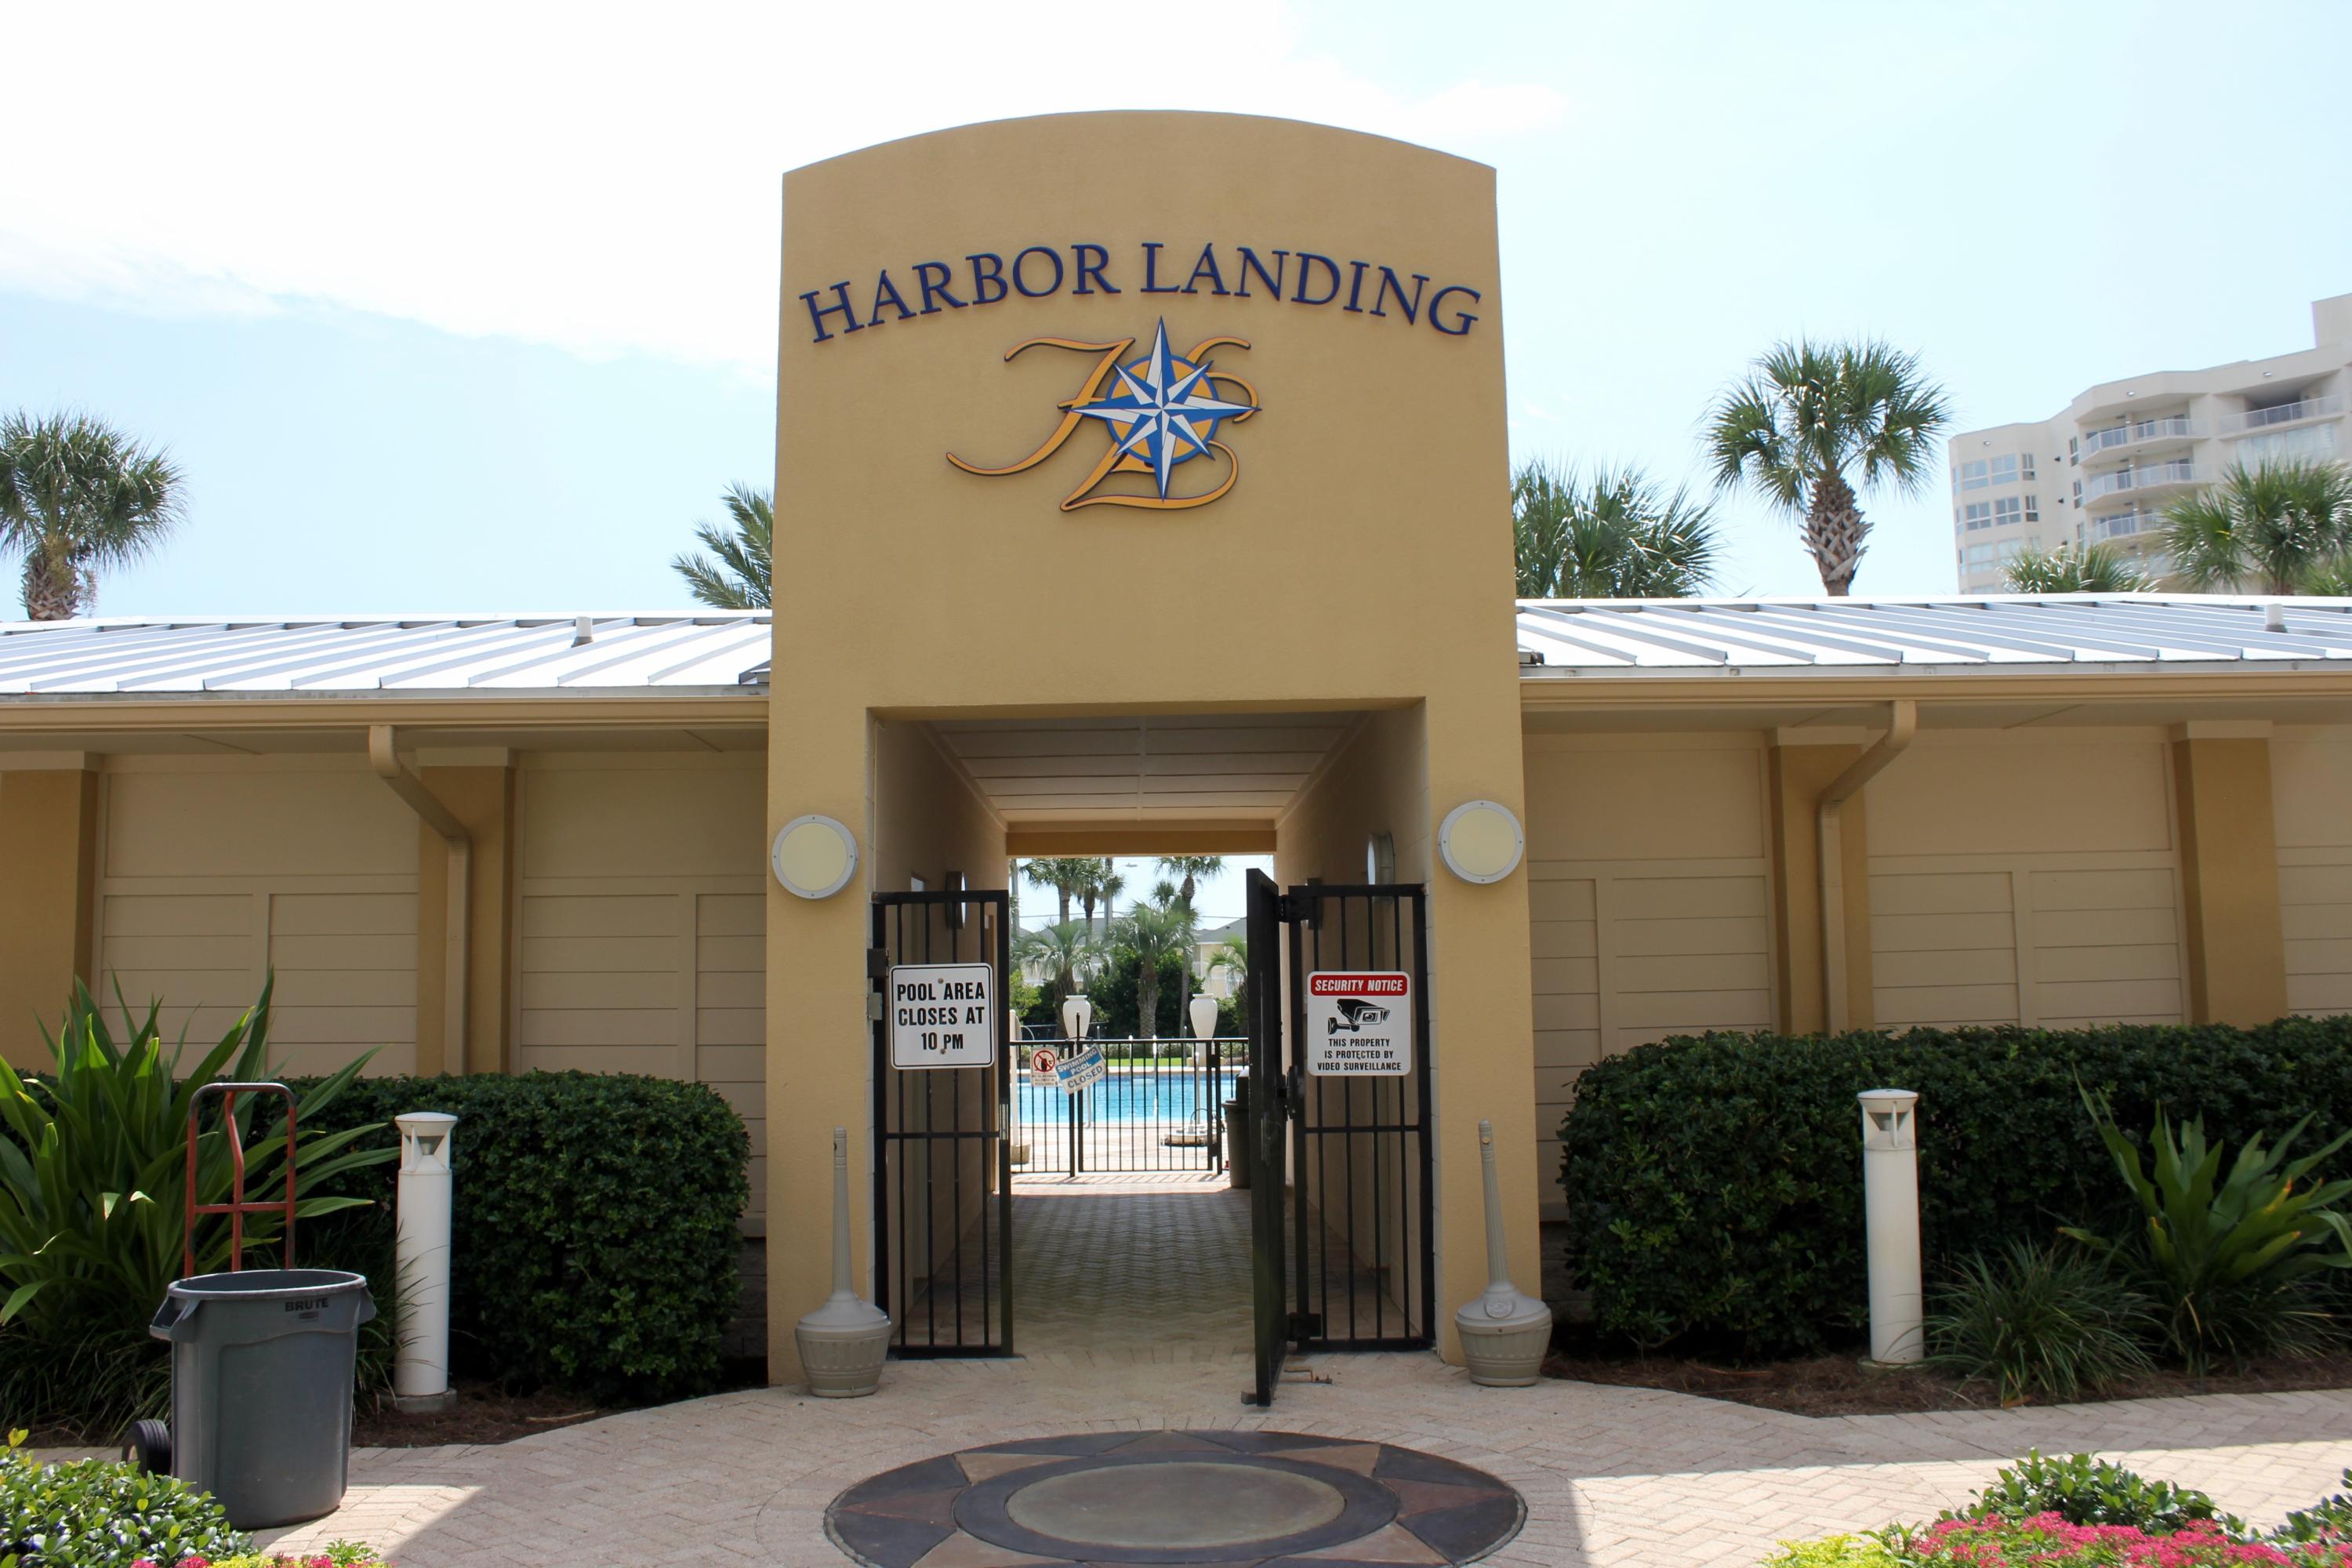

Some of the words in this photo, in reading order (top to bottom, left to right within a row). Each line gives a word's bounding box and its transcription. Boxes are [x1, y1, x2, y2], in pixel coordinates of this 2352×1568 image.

[799, 244, 1121, 343] HARBOR
[1140, 242, 1481, 336] LANDING
[897, 983, 936, 1001] POOL
[943, 982, 985, 1000] AREA
[1315, 979, 1363, 992] SECURITY
[1367, 979, 1403, 992] NOTICE
[898, 1007, 958, 1026] CLOSES
[965, 1007, 985, 1025] AT
[921, 1032, 938, 1051] 10
[943, 1033, 964, 1050] PM
[1328, 1038, 1346, 1047] THIS
[1350, 1038, 1390, 1047] PROPERTY
[1057, 1048, 1097, 1072] SWIMMING
[1324, 1051, 1333, 1059] IS
[1336, 1051, 1381, 1059] PROTECTED
[1070, 1061, 1091, 1075] POOL
[1317, 1062, 1341, 1071] VIDEO
[1344, 1062, 1402, 1071] SURVEILLANCE
[1068, 1065, 1102, 1088] CLOSED
[285, 1298, 329, 1312] BRUTE
